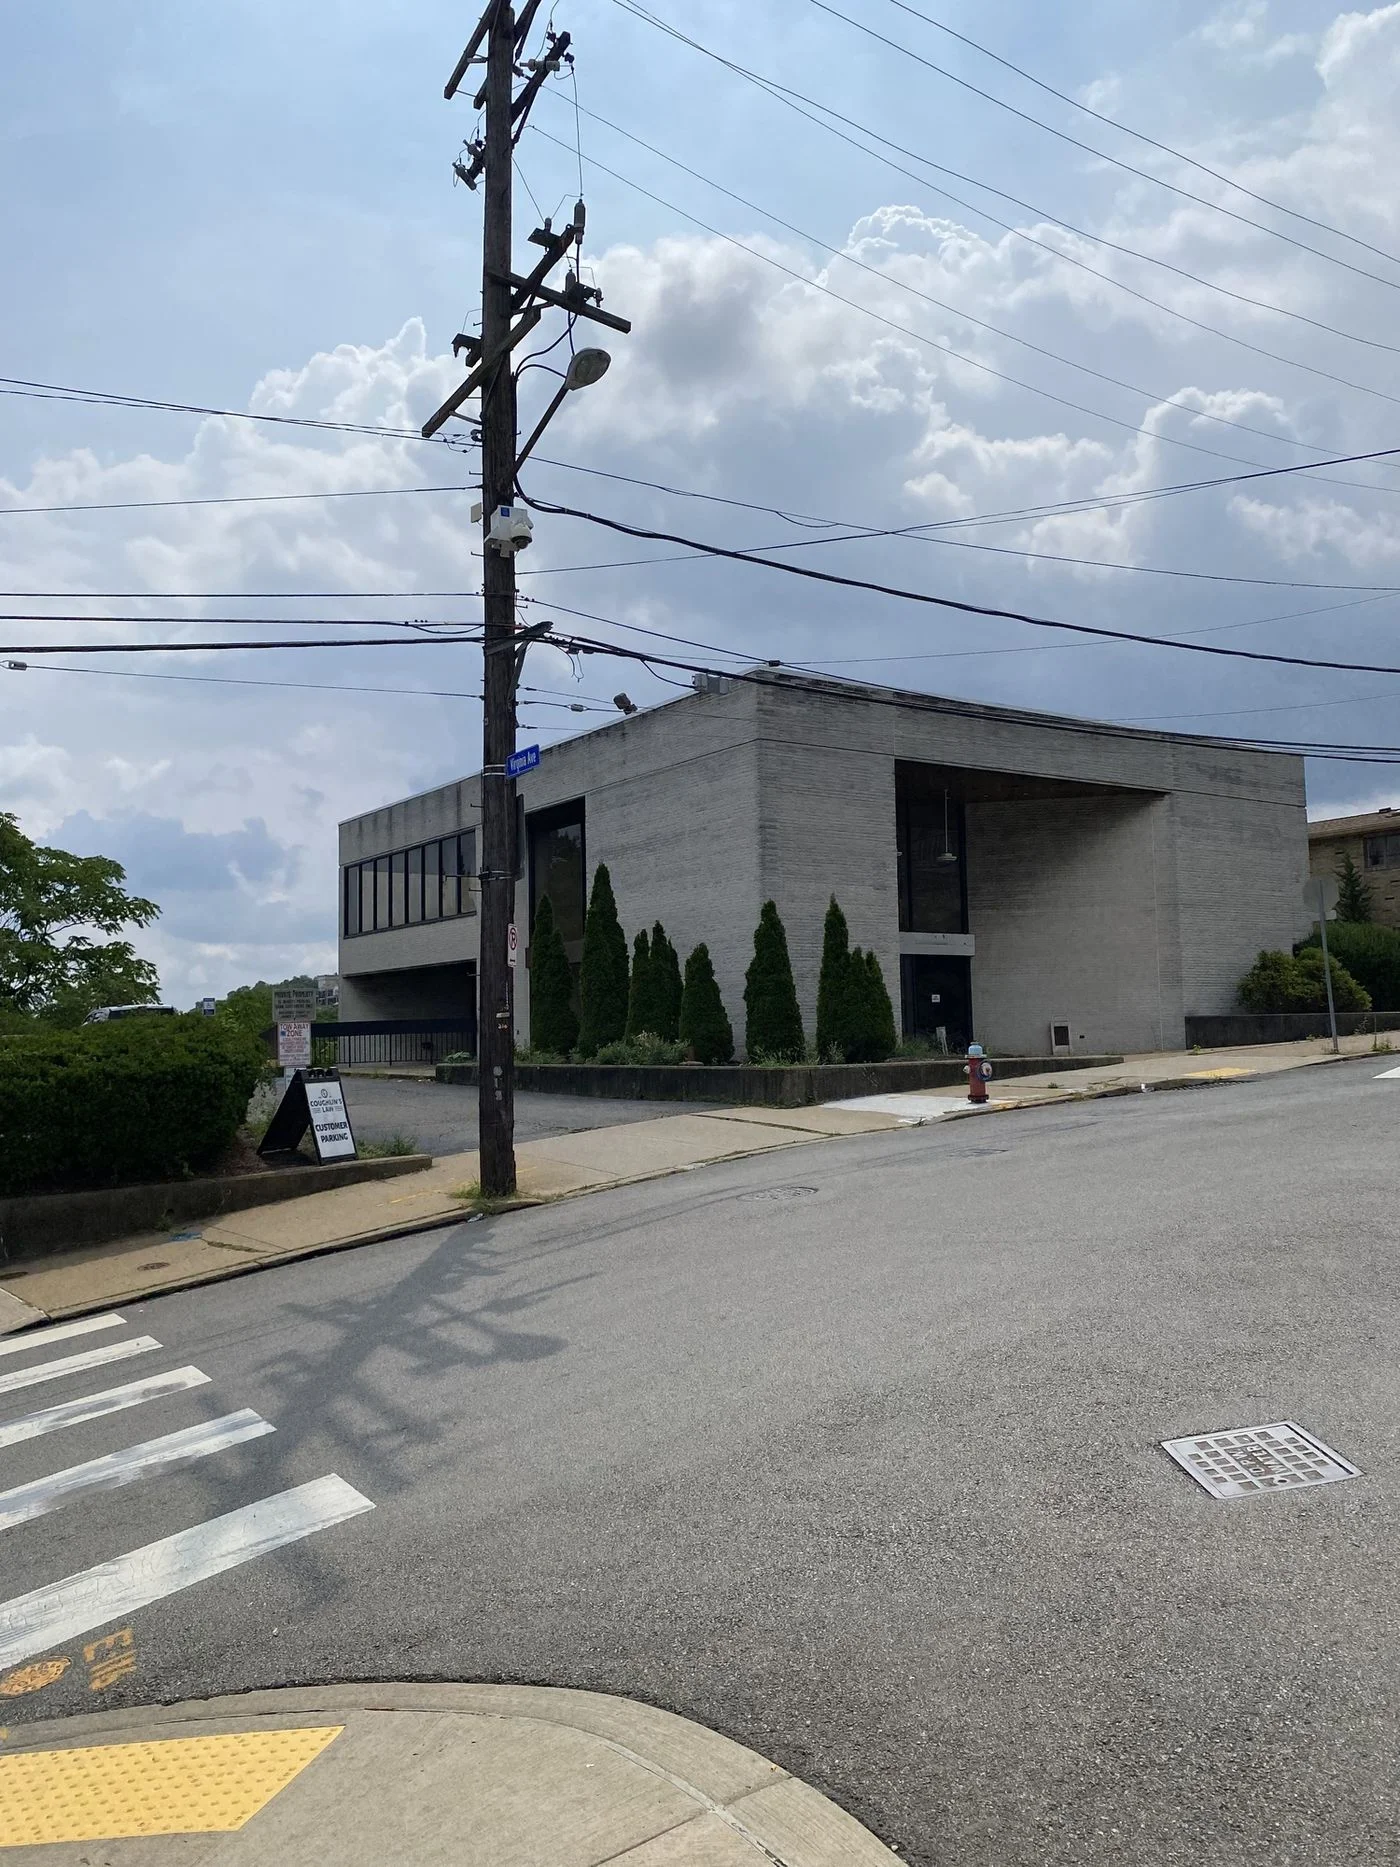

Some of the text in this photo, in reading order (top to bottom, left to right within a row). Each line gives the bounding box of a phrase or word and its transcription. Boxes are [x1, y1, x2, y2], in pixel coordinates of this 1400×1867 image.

[527, 751, 537, 765] Ave
[287, 1029, 302, 1037] ZONE
[310, 1099, 342, 1107] COUGHLIN'S
[315, 1121, 348, 1132] CUSTOMER
[320, 1132, 349, 1143] PARKING
[1246, 1444, 1288, 1474] WATER
